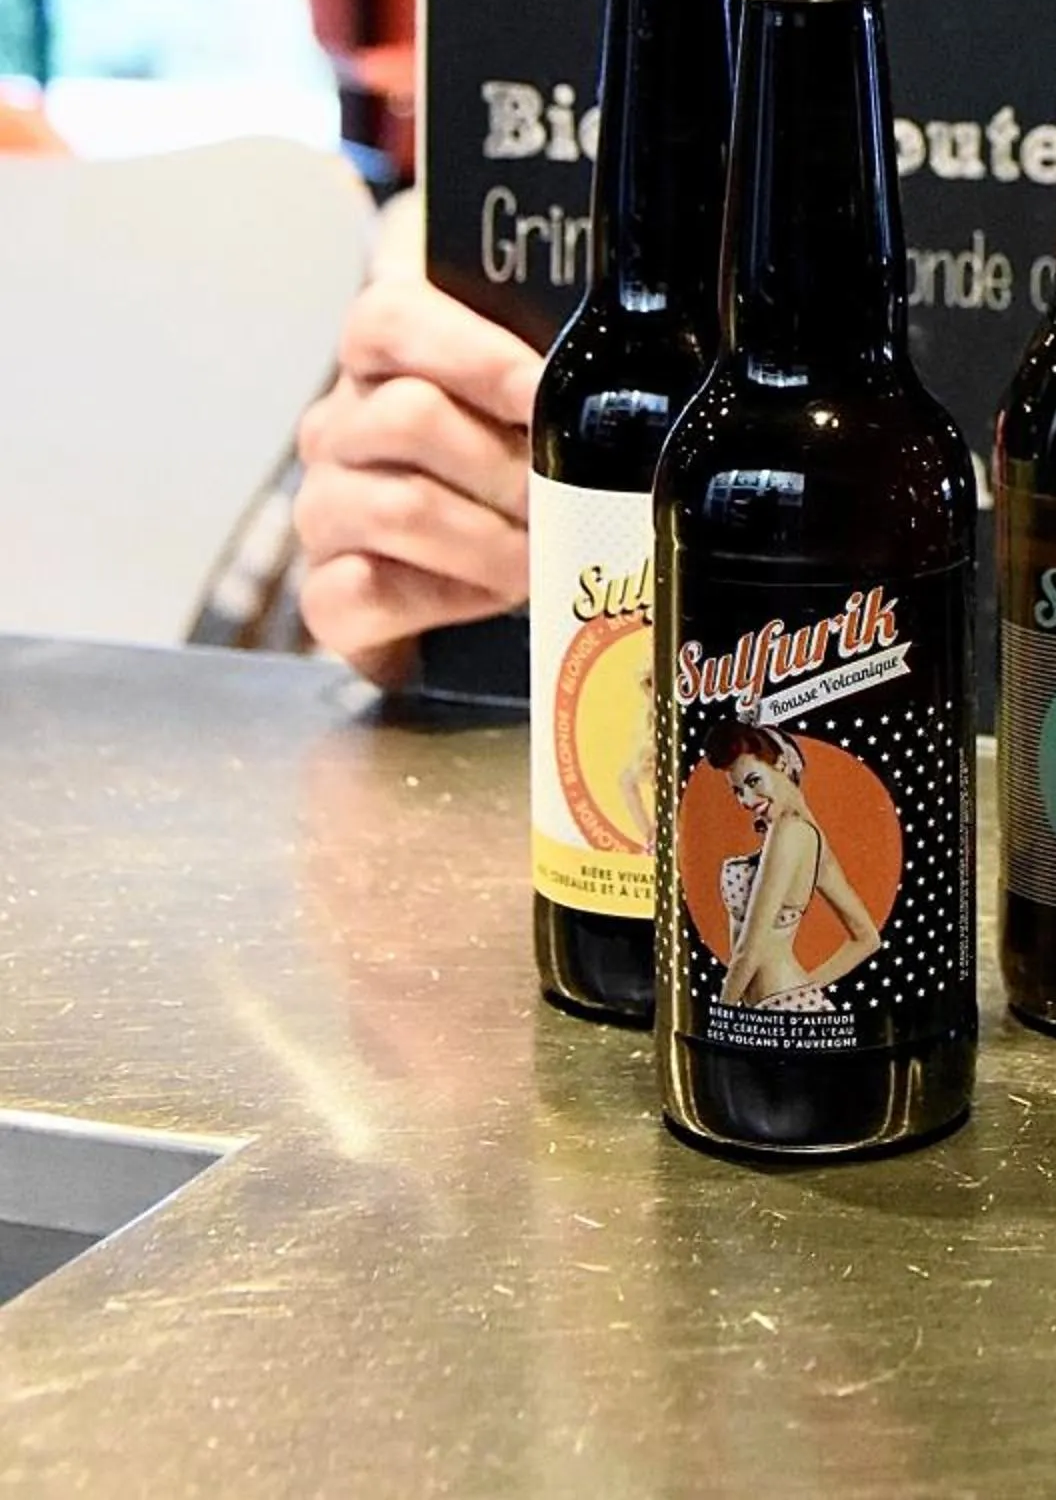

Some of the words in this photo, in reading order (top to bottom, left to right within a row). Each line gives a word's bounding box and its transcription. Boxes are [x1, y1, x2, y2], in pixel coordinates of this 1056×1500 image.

[675, 586, 898, 711] Sulfurik
[769, 688, 818, 716] Rousse
[819, 656, 898, 695] Volcanique
[727, 1033, 778, 1048] VOLCANS
[783, 1037, 857, 1049] D'AUVERGNE
